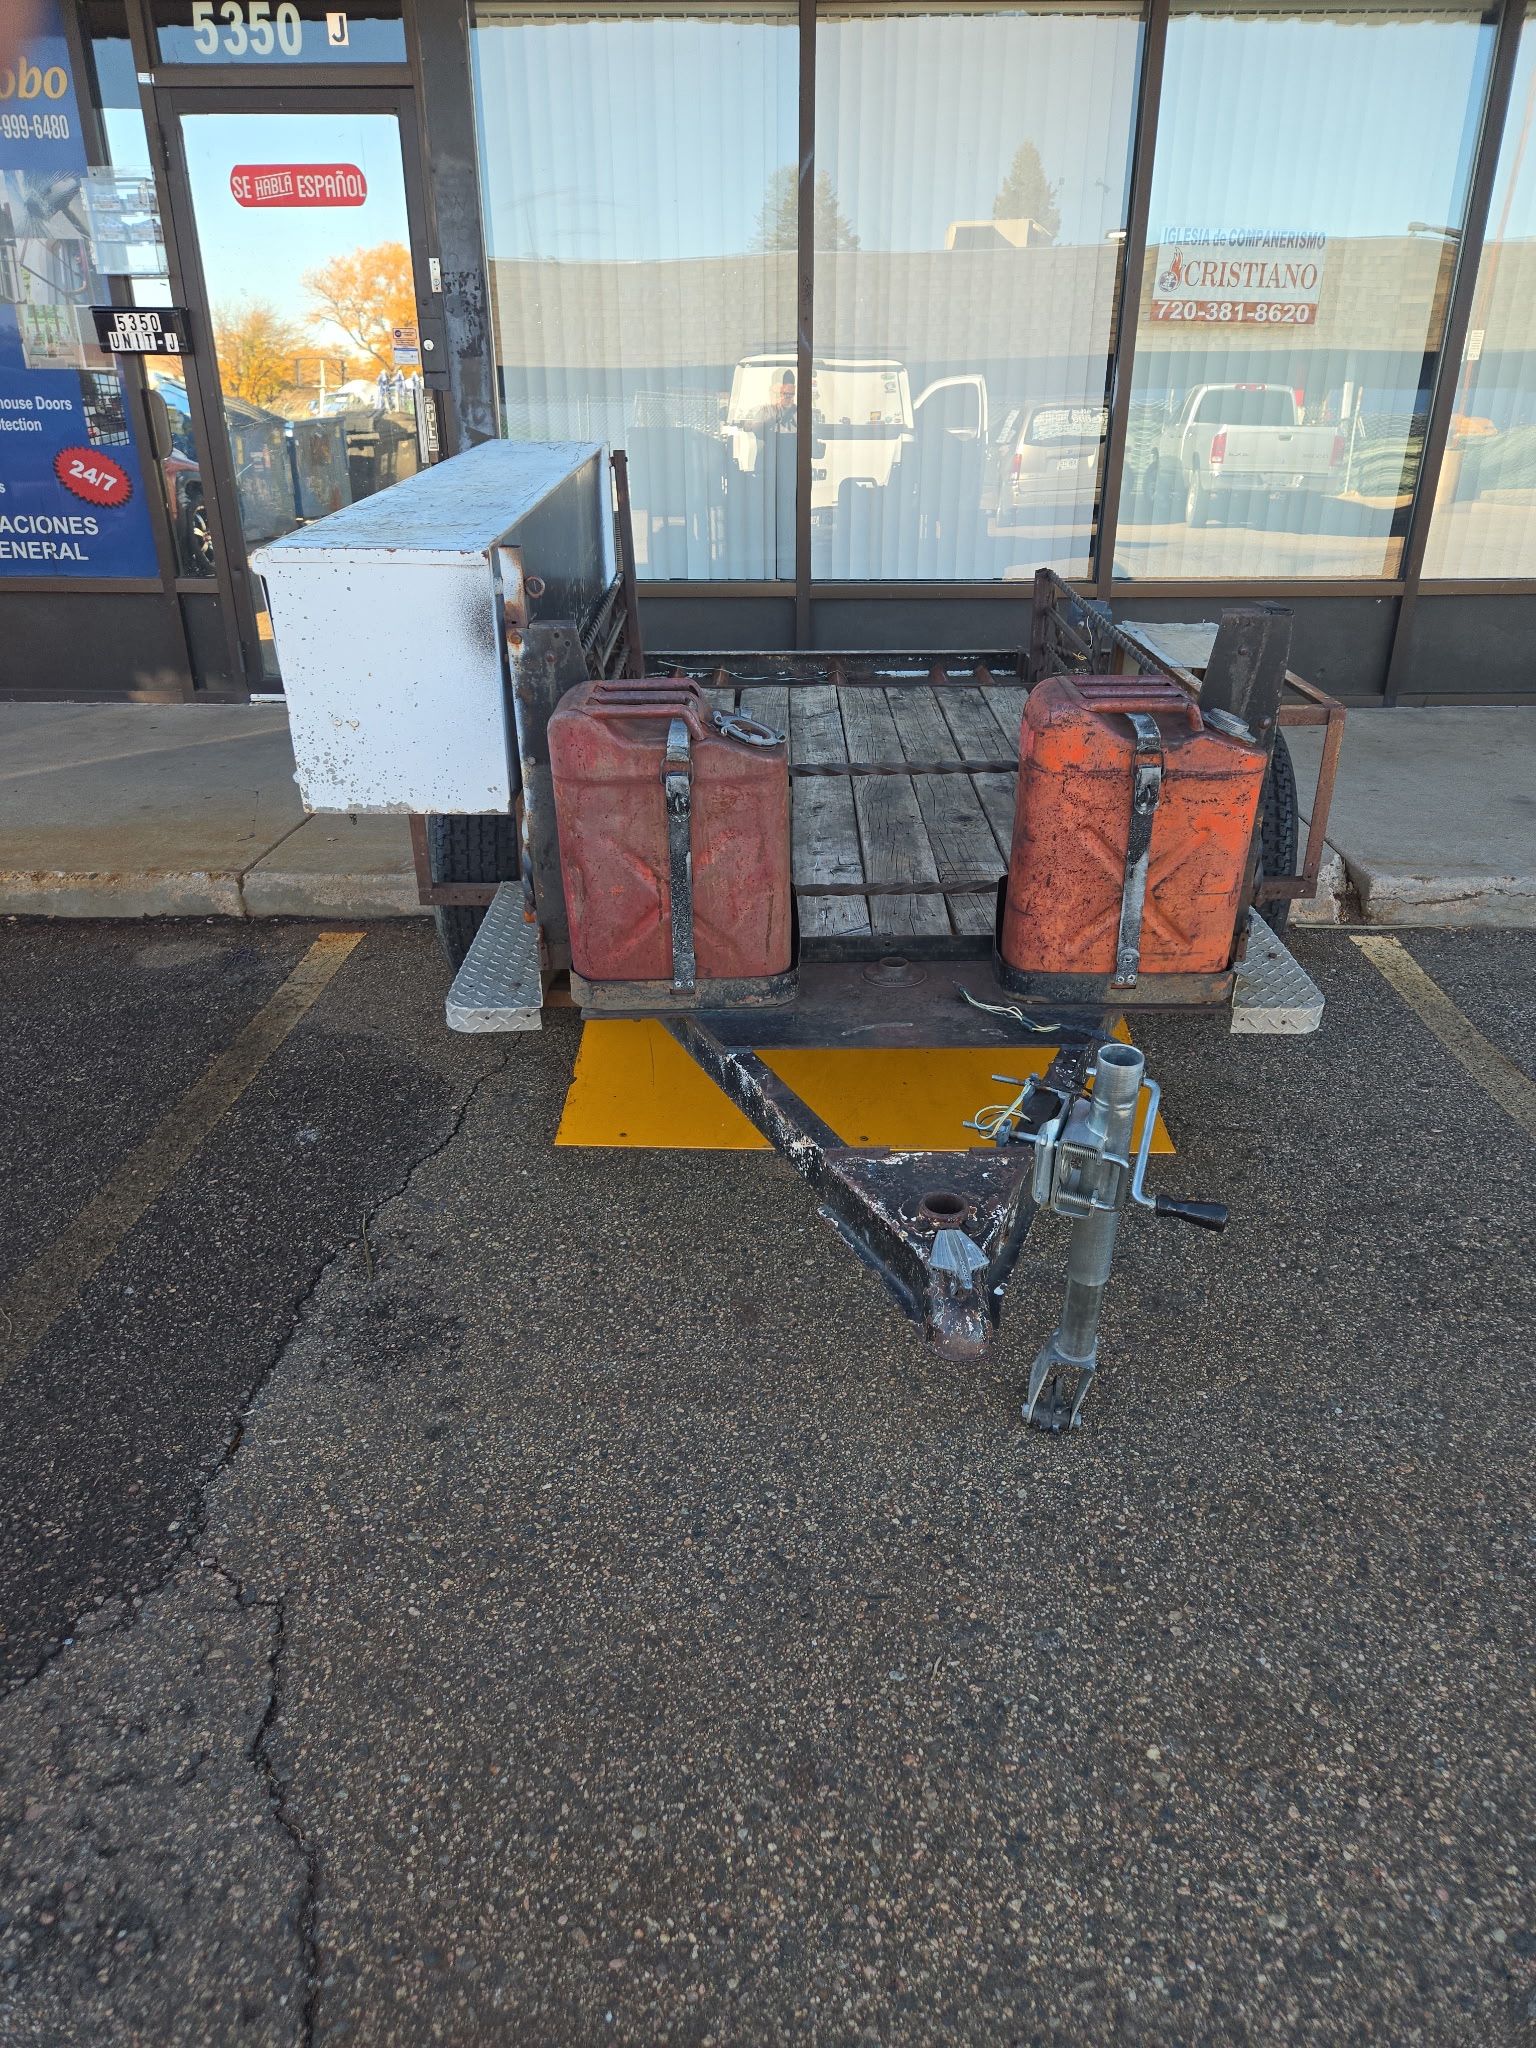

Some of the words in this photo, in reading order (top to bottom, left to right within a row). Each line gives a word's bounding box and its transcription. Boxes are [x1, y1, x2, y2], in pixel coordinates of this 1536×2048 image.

[192, 1, 302, 55] 5350
[331, 15, 346, 43] J
[232, 176, 252, 199] SE
[255, 174, 293, 197] HABLA
[297, 170, 366, 198] ESPAÑOL
[1163, 227, 1210, 246] IGLESIA
[1213, 229, 1227, 246] de
[1184, 260, 1318, 290] CRISTIANO
[1157, 301, 1310, 323] 720-381-8620
[116, 314, 159, 332] 5350
[35, 396, 73, 410] Doors
[0, 417, 43, 431] tection
[425, 403, 437, 441] PULL
[69, 459, 117, 491] 24/7
[0, 516, 99, 536] ACIONES
[0, 541, 89, 561] ENERAL
